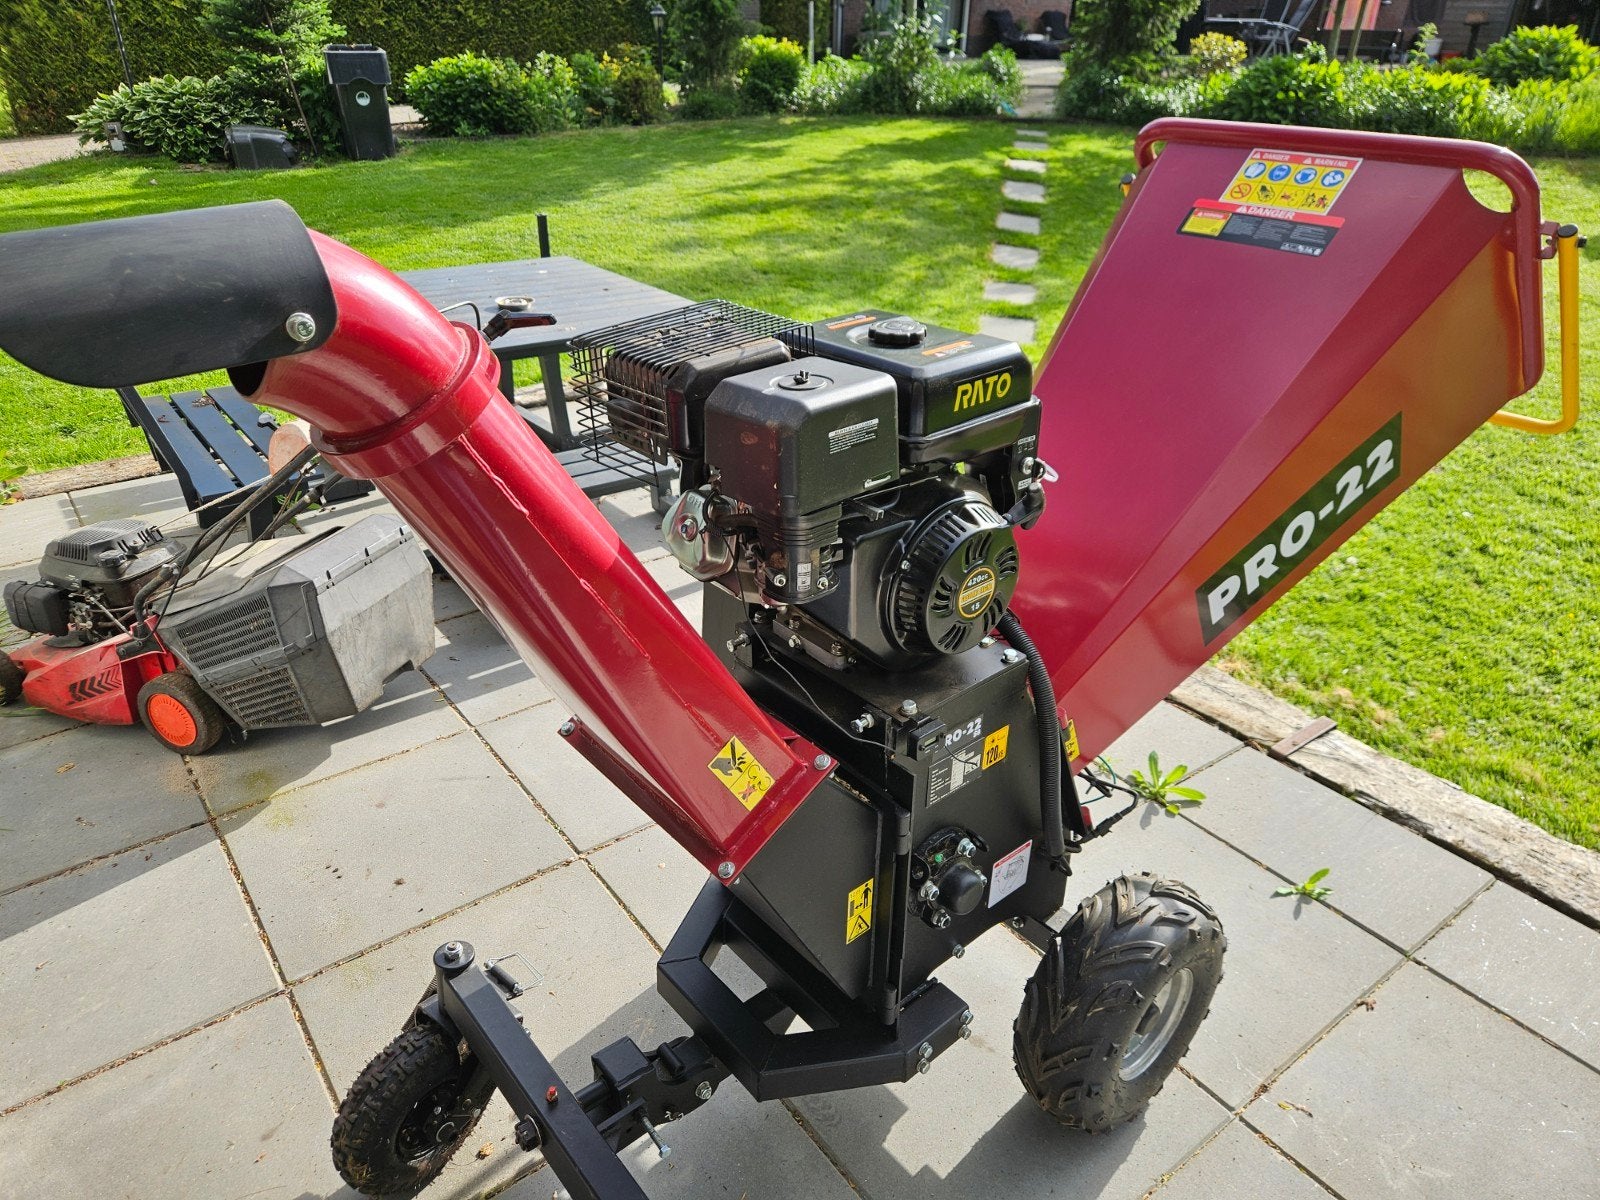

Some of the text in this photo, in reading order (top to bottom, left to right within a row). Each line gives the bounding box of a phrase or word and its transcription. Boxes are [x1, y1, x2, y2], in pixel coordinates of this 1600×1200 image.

[1262, 153, 1290, 161] DANGER
[1314, 159, 1348, 167] WARNING
[1248, 206, 1296, 219] DANGER
[953, 372, 1012, 412] RATO
[1207, 439, 1394, 625] PRO-22
[945, 717, 982, 748] RO-22
[986, 745, 999, 766] 120
